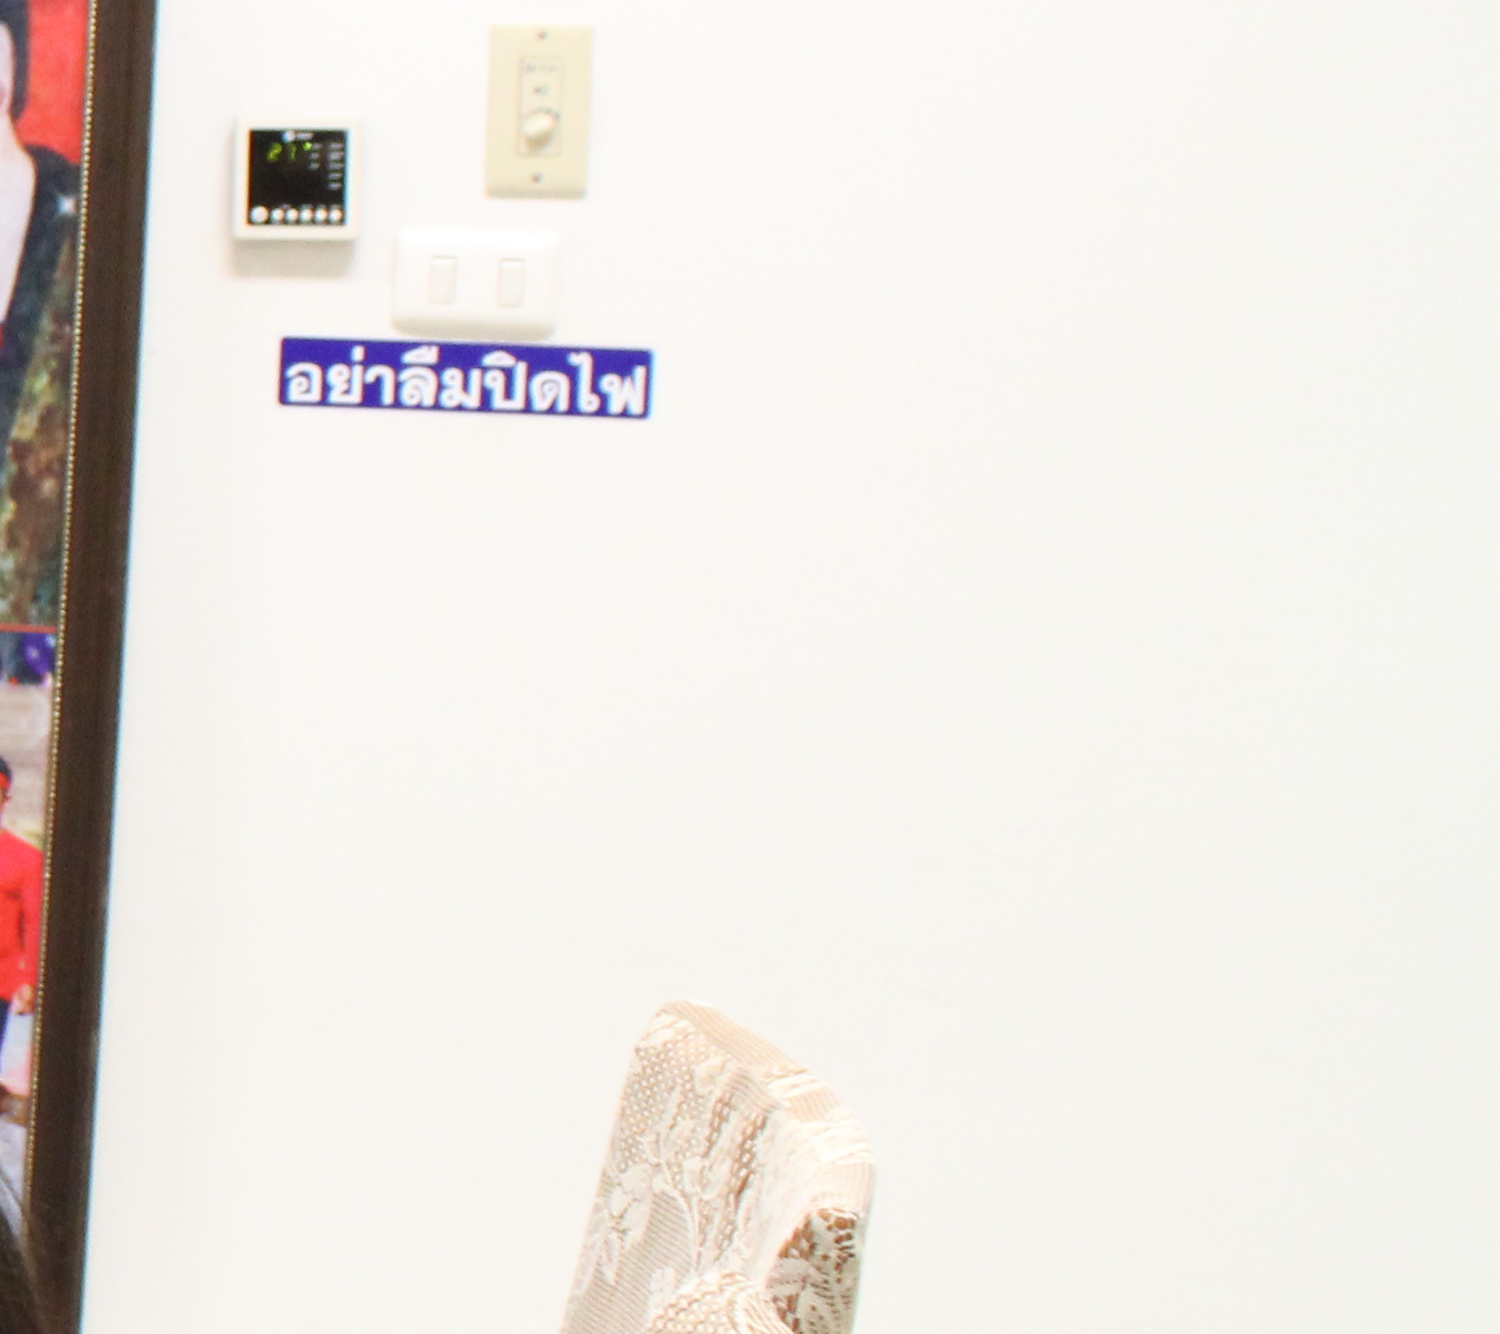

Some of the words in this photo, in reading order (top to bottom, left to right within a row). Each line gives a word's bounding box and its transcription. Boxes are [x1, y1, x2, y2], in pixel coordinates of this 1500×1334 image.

[285, 345, 649, 417] อย่าลืมปิดไฟ
